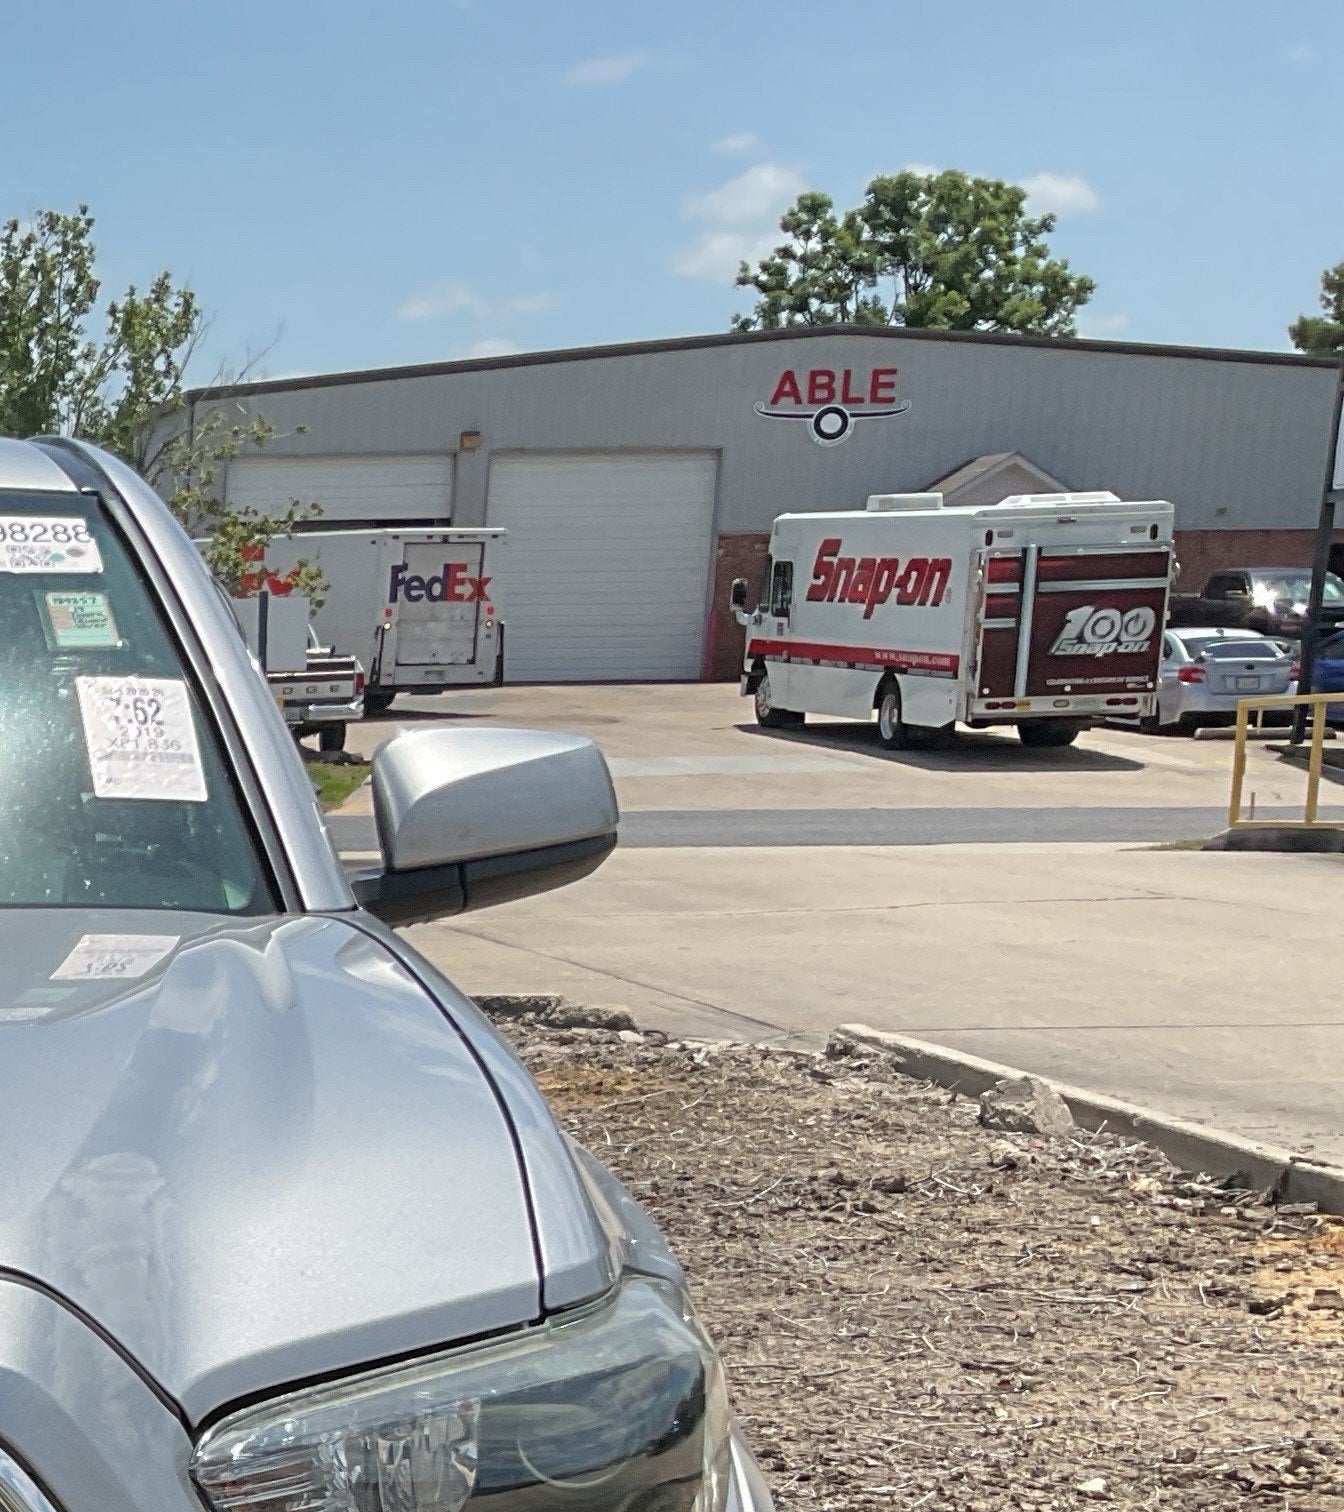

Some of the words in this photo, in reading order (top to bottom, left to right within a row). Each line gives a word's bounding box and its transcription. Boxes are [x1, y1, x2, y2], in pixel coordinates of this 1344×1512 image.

[770, 368, 898, 405] ABLE
[389, 561, 493, 603] FedEx
[806, 538, 952, 620] Snap-on
[1050, 605, 1156, 653] 100
[1054, 638, 1151, 657] Snap-on
[283, 684, 340, 695] DGE
